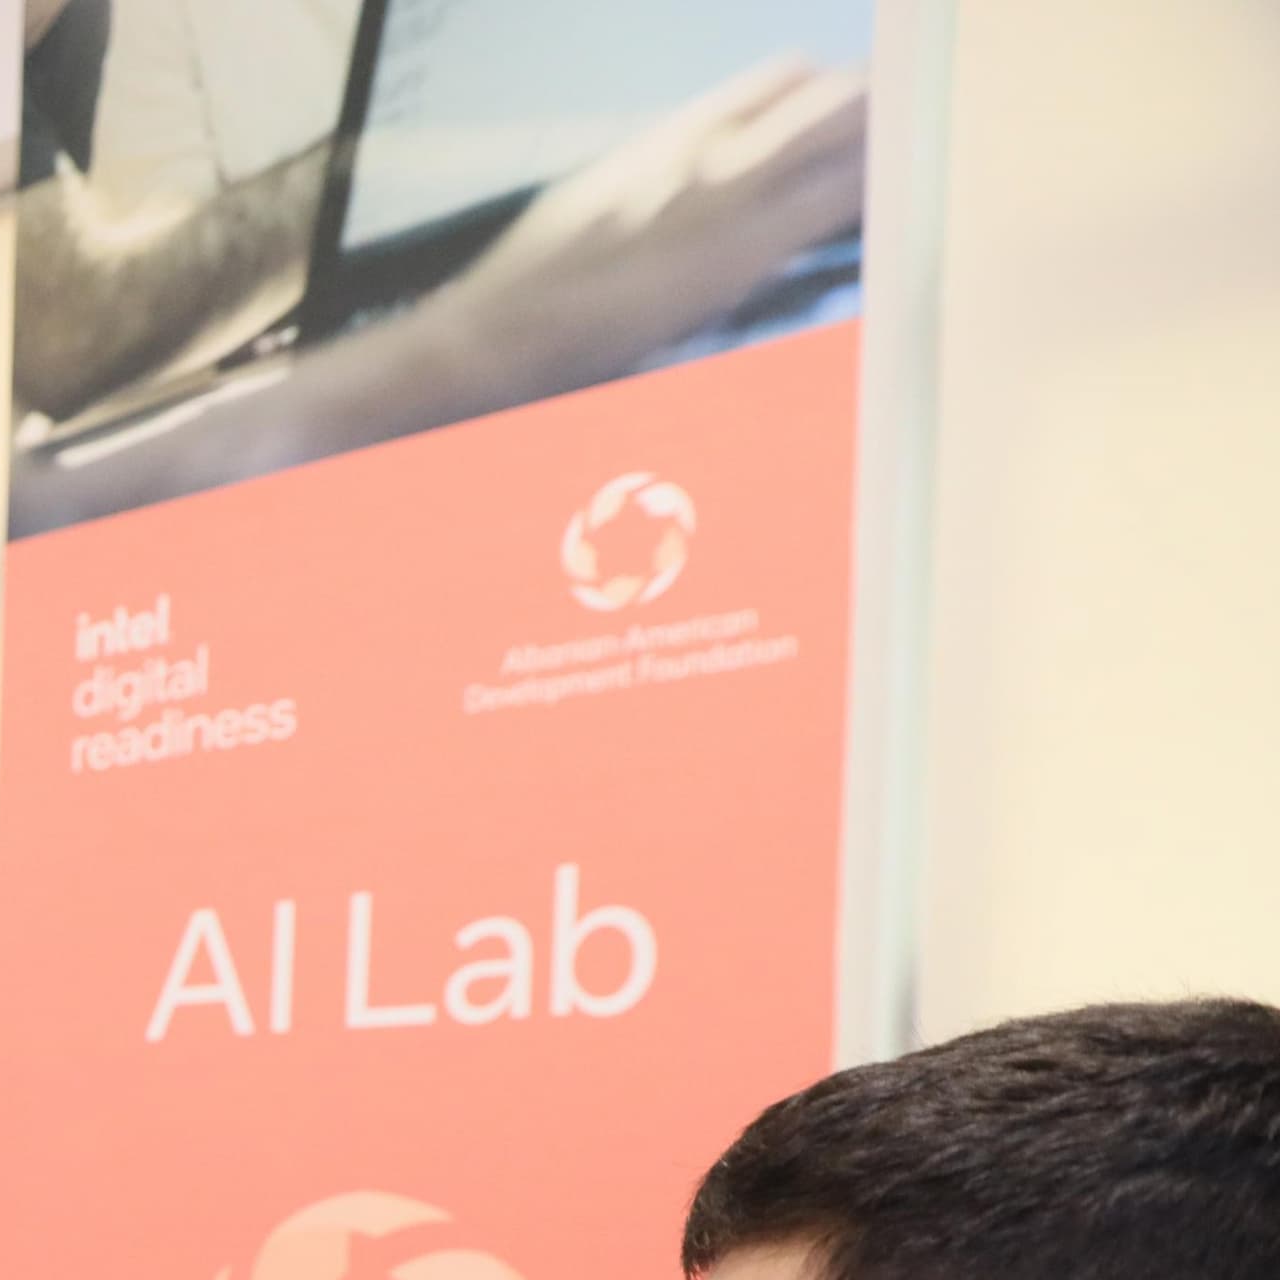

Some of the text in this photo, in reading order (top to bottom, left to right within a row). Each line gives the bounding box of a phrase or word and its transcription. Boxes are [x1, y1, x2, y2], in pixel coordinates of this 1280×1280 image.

[75, 592, 170, 662] intel
[71, 641, 209, 721] digital
[71, 697, 298, 775] readiness
[145, 862, 658, 1043] AI Lab
